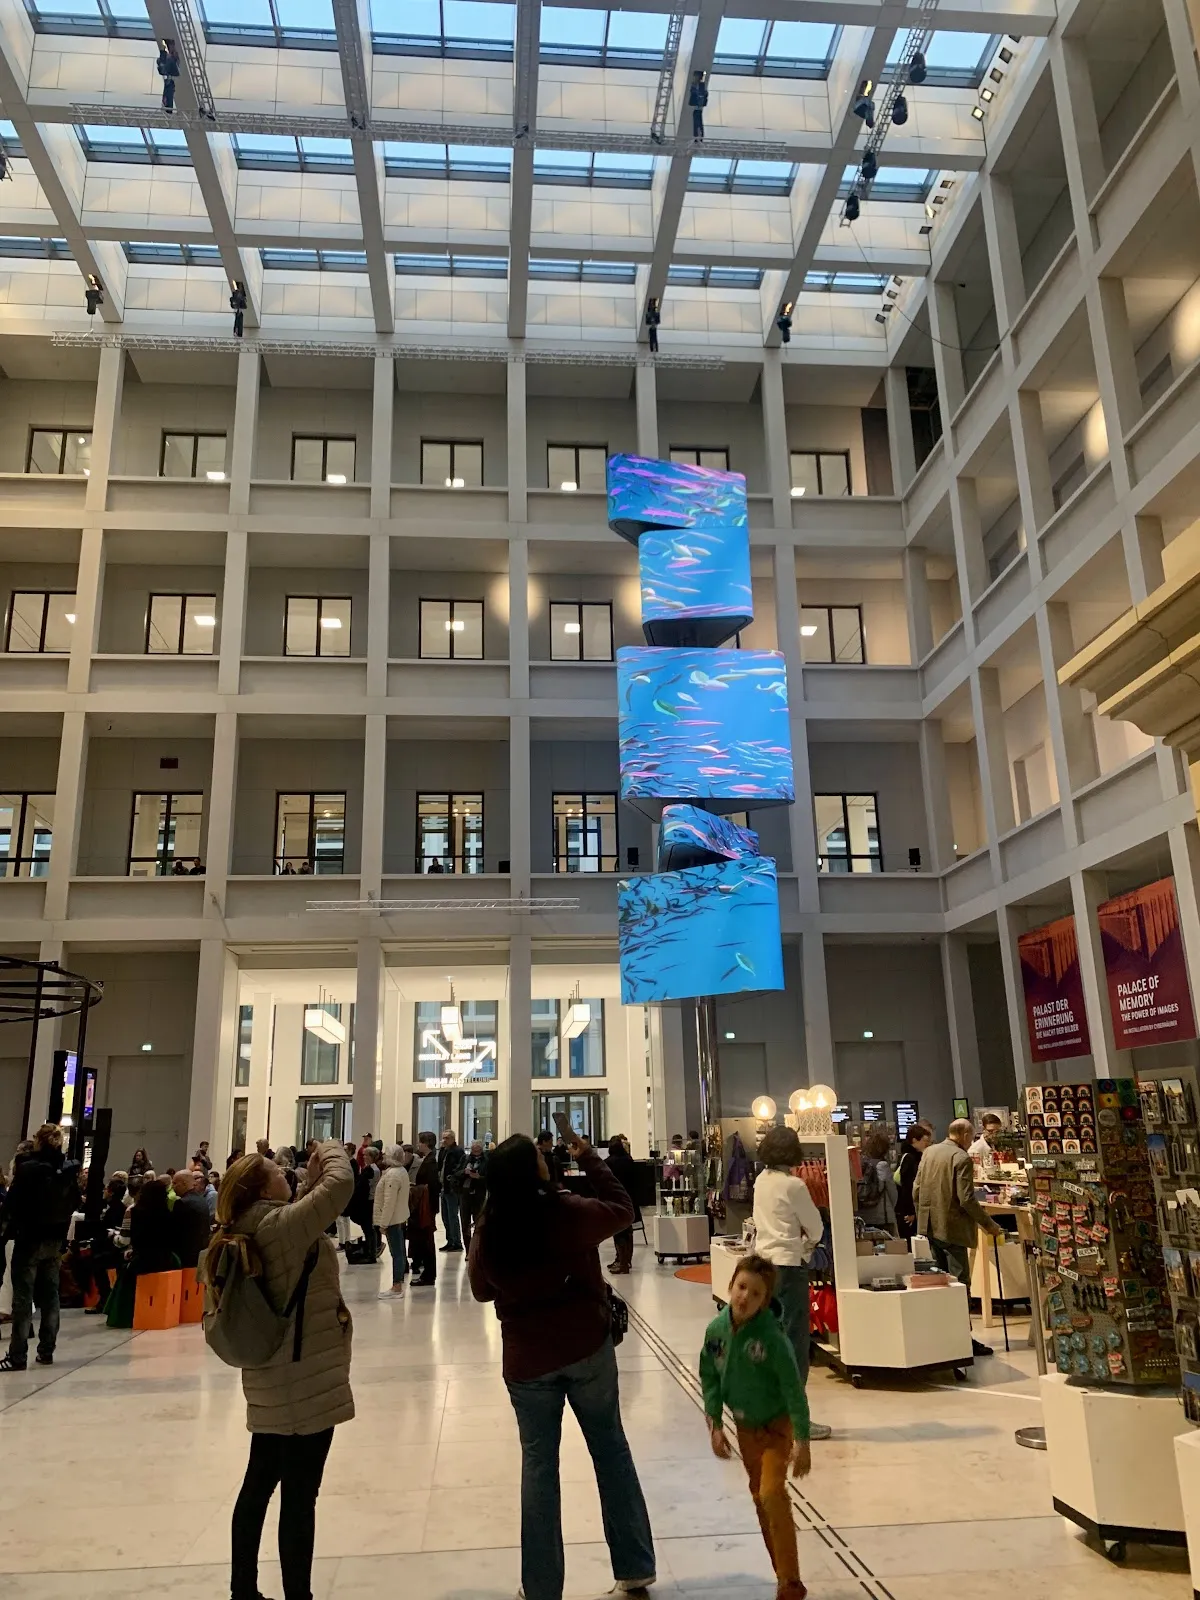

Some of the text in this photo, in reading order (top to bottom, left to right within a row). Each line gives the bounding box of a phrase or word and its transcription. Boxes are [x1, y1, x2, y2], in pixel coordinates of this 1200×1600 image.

[1117, 975, 1160, 997] PALACE OF
[1033, 998, 1069, 1016] PALAST DER
[1119, 992, 1154, 1011] MEMORY
[1035, 1011, 1074, 1029] ERINNERUNG
[1121, 1003, 1179, 1022] THE POWER OF IMAGES
[1035, 1023, 1079, 1039] DIE MACHT DER BILDER
[957, 1104, 964, 1113] A
